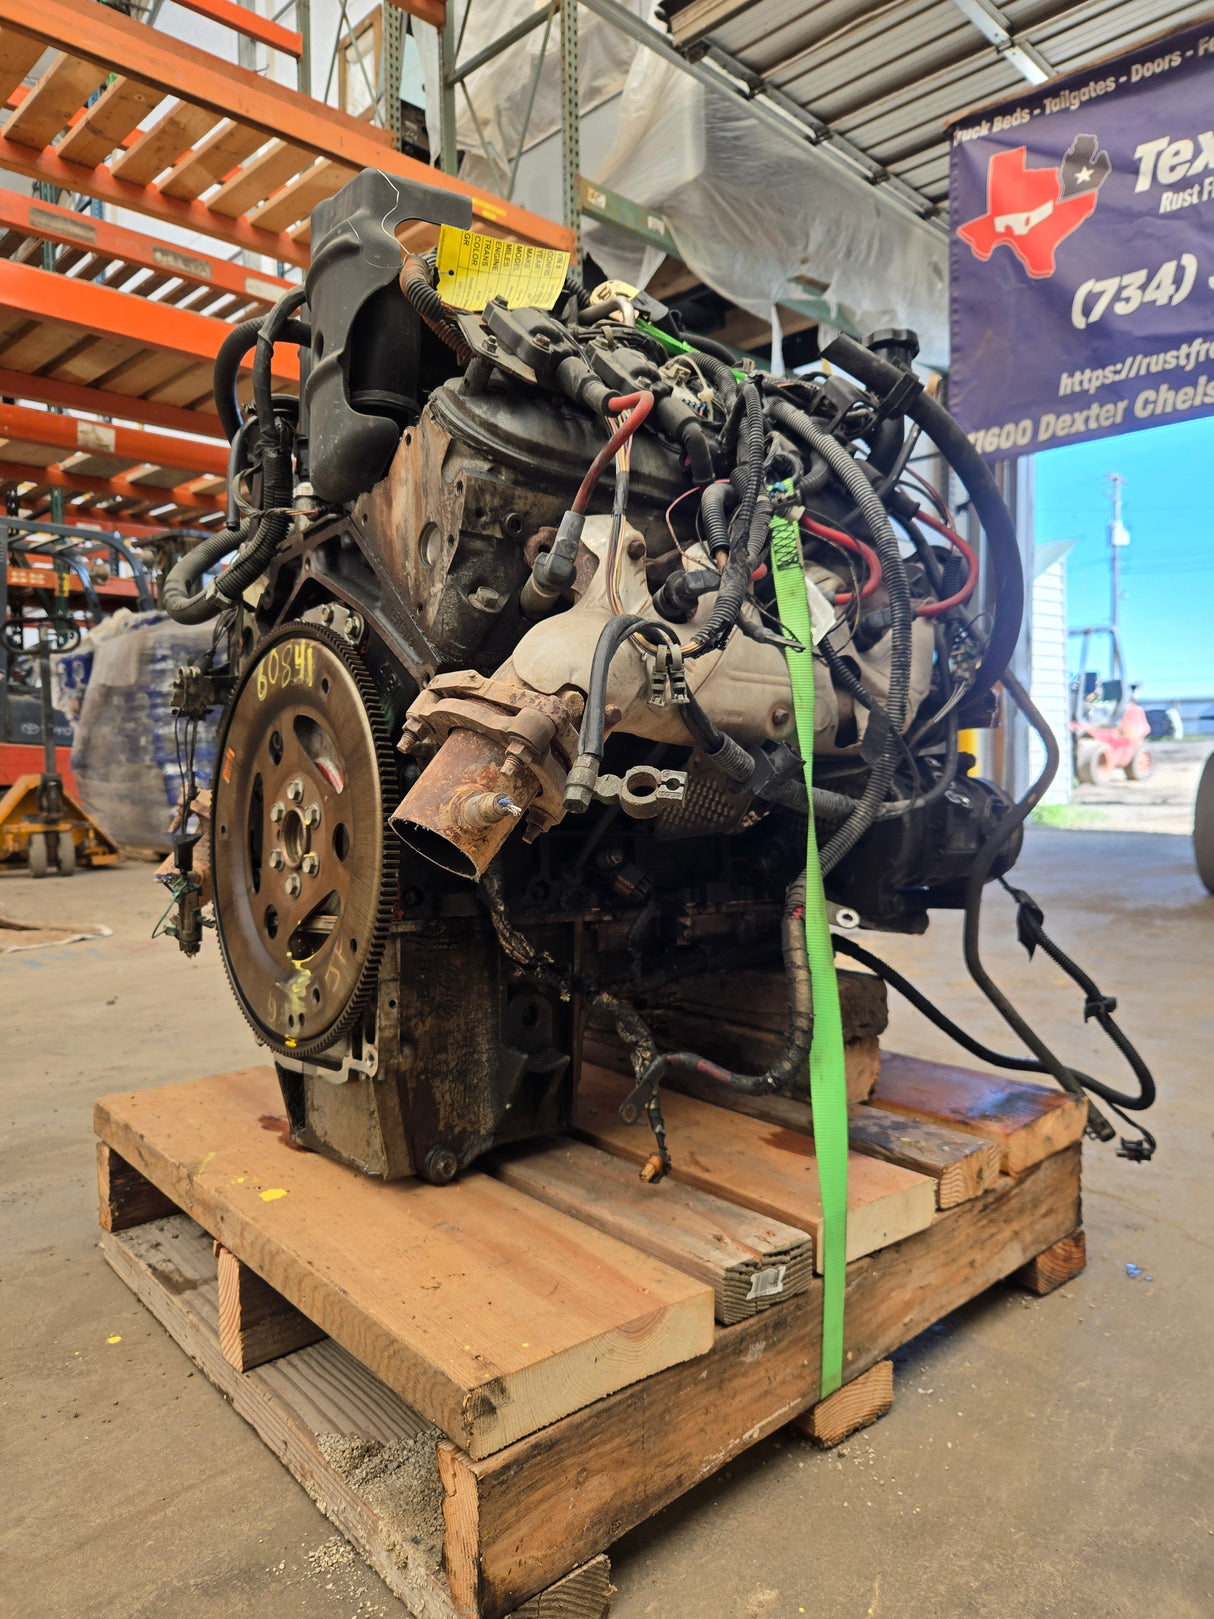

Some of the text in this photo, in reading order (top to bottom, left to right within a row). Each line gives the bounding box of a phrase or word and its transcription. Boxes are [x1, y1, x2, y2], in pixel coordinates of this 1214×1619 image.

[992, 107, 1031, 134] Beds
[1043, 76, 1116, 115] Tailgates
[1131, 50, 1182, 83] Doors
[1159, 176, 1214, 214] Rust F
[463, 232, 472, 247] GR
[472, 235, 481, 267] COLOR
[482, 239, 491, 267] TRANS
[492, 241, 502, 271] ENGINE
[503, 244, 512, 267] MILES
[513, 246, 523, 272] MODEL
[1071, 252, 1198, 330] (734)
[1037, 398, 1130, 443] Dexter
